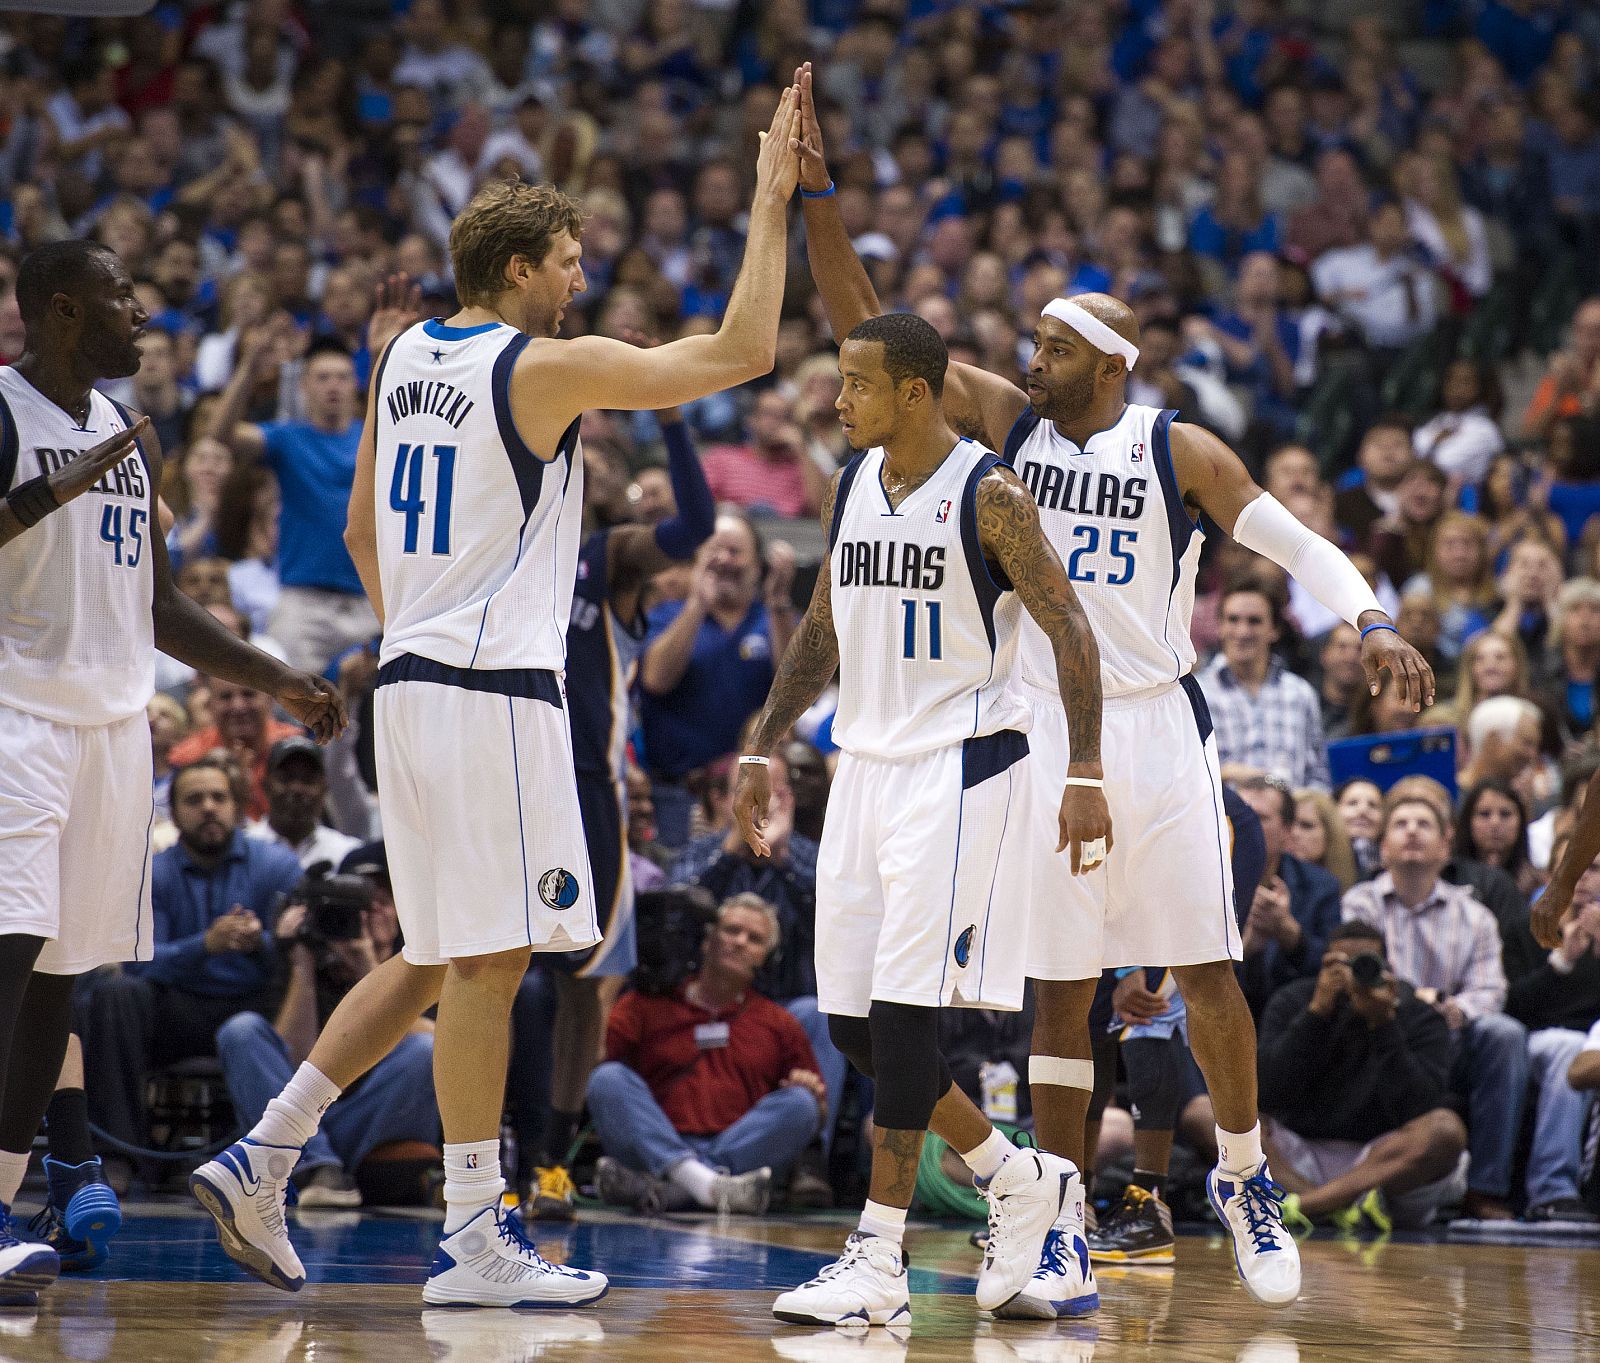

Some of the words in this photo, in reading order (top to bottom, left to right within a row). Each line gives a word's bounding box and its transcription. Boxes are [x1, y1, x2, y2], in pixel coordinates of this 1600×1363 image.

[387, 379, 475, 430] NOWITZKI
[388, 441, 459, 557] 41
[1021, 460, 1149, 521] DALLAS
[99, 503, 147, 568] 45
[840, 540, 948, 591] DALLAS
[1067, 523, 1140, 587] 25
[900, 597, 944, 662] 11
